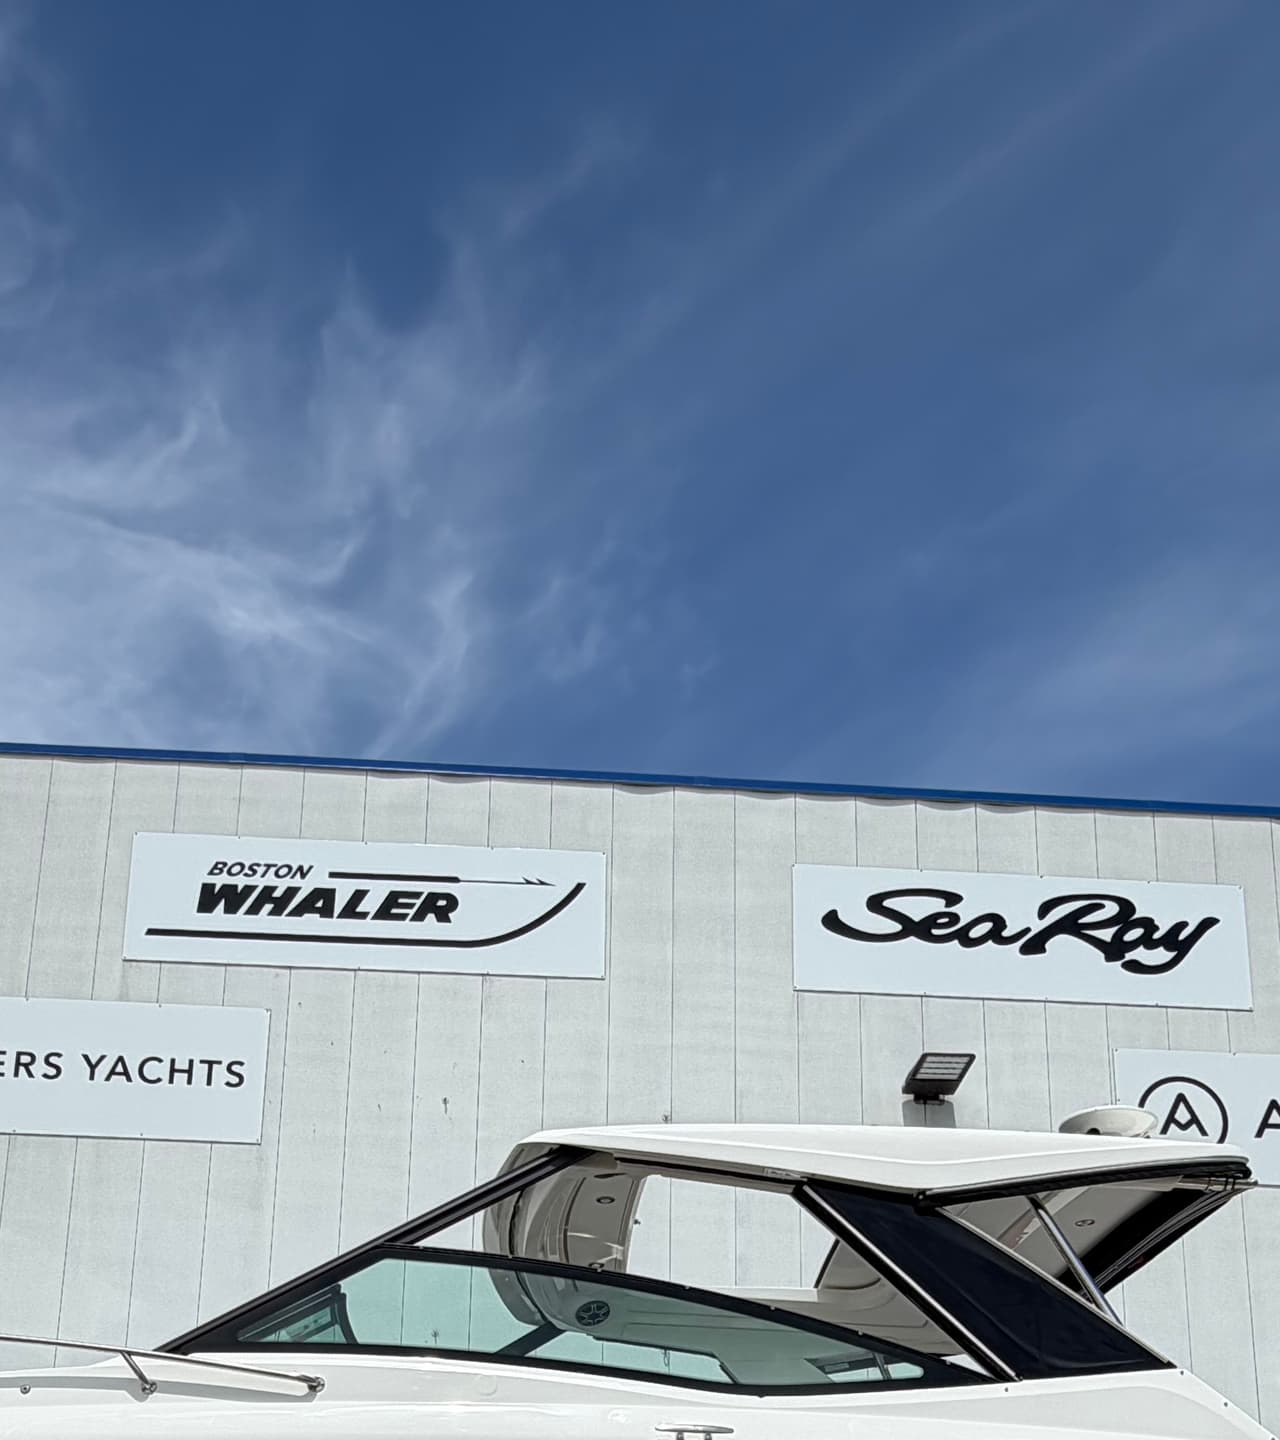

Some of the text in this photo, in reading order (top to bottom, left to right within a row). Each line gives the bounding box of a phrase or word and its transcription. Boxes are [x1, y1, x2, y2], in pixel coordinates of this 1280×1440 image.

[207, 861, 314, 880] BOSTON
[196, 882, 459, 924] WHALER
[821, 887, 1221, 975] Sea Ray
[81, 1053, 245, 1088] YACHTS
